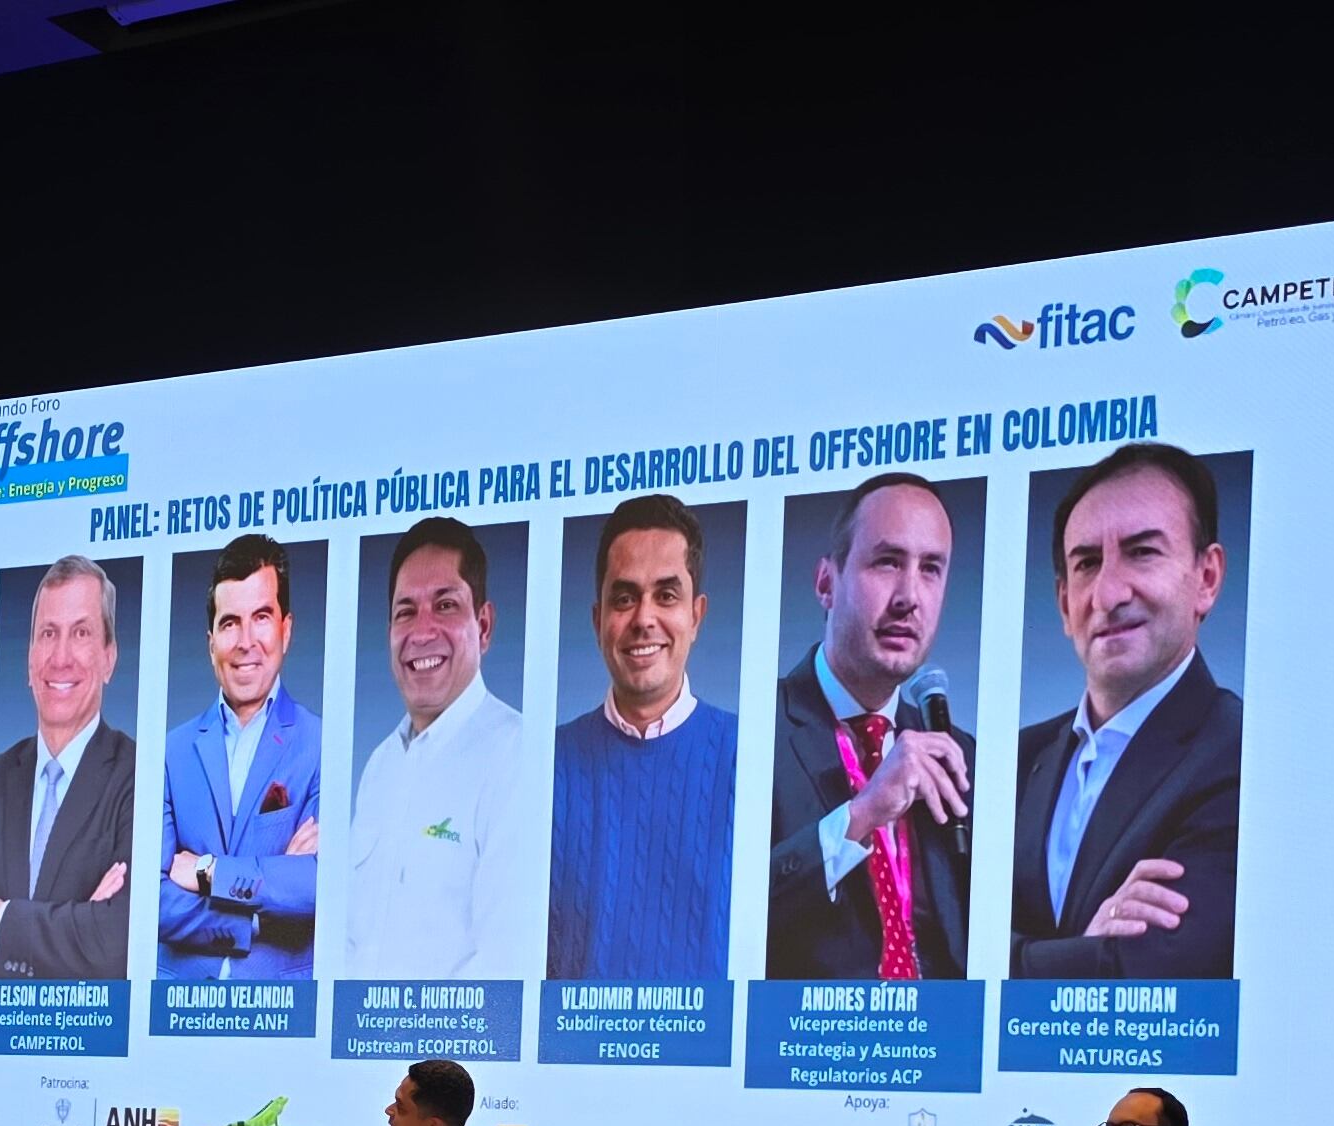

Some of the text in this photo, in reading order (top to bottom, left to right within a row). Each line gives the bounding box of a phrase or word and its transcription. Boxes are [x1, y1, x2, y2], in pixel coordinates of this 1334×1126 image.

[1037, 303, 1135, 349] fitac
[32, 398, 60, 413] Foro
[90, 394, 1158, 542] PANEL: RETOS DE POLÍTICA PÚBLICA PARA EL DESARROLLO DEL OFFSHORE EN COLOMBIA
[9, 480, 54, 499] Energía
[58, 481, 66, 495] y
[68, 473, 125, 492] Progreso
[40, 981, 109, 1007] CASTAÑEDA
[167, 985, 294, 1008] ORLANDO VELANDIA
[364, 986, 400, 1009] JUAN
[420, 986, 485, 1009] HURTADO
[561, 986, 704, 1011] VLADIMIR MURILLO
[801, 981, 919, 1012] ANDRES BÍTAR
[1050, 986, 1177, 1013] JORGE DURAN
[55, 1011, 113, 1030] Ejecutivo
[169, 1012, 289, 1031] Presidente ANH
[356, 1013, 489, 1033] Vicepresidente Seg.
[556, 1014, 706, 1032] Subdirector técnico
[789, 1015, 928, 1036] Vicepresidente de
[1007, 1018, 1220, 1041] Gerente de Regulación
[9, 1035, 85, 1050] CAMPETROL
[347, 1038, 497, 1056] Upstream ECOPETROL
[599, 1042, 660, 1059] FENOGE
[779, 1041, 937, 1062] Estrategia y Asuntos
[1059, 1048, 1163, 1066] NATURGAS
[40, 1075, 89, 1089] Patrocina:
[790, 1067, 923, 1087] Regulatorios ACP
[844, 1095, 890, 1112] Apoya:
